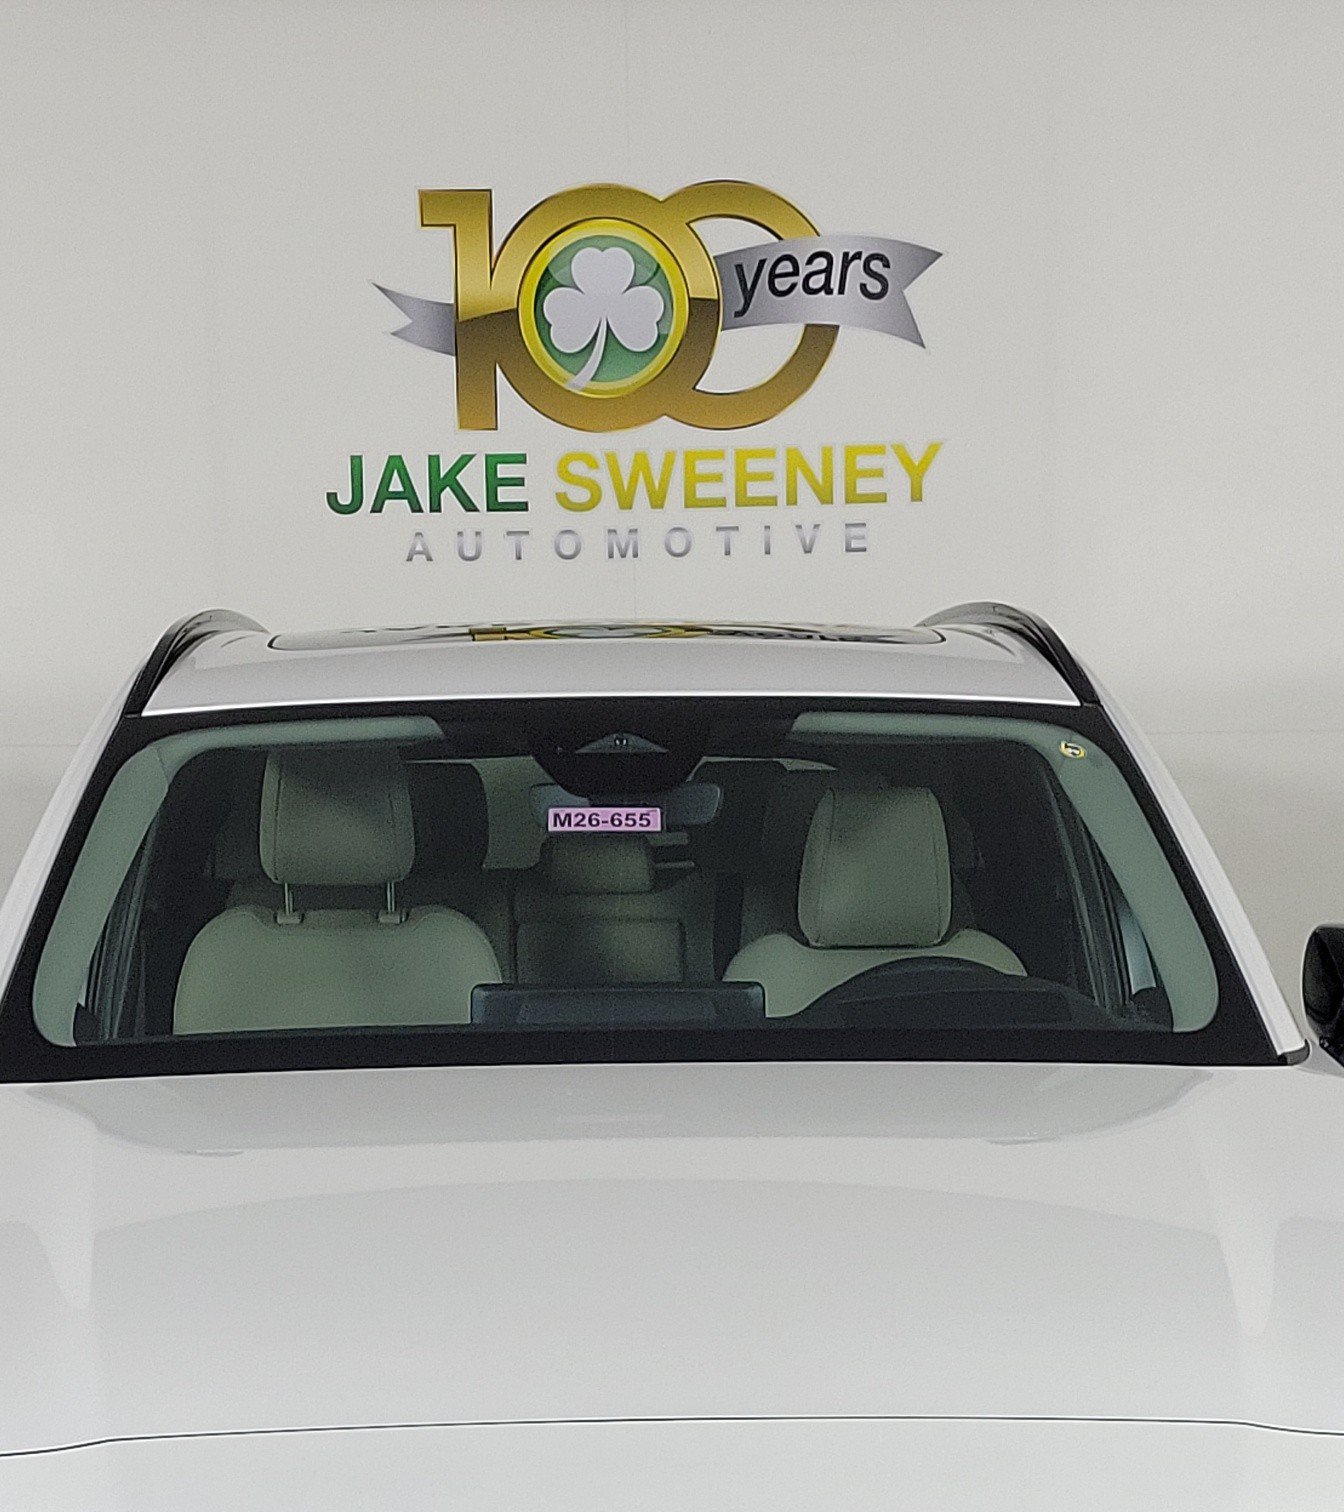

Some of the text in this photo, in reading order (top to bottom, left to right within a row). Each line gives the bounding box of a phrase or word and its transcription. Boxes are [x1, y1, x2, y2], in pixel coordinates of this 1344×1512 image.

[418, 180, 891, 432] 100 years
[325, 442, 943, 515] JAKE SWEENEY
[406, 522, 868, 562] AUTOMOTIVE
[552, 812, 652, 828] M26-655
